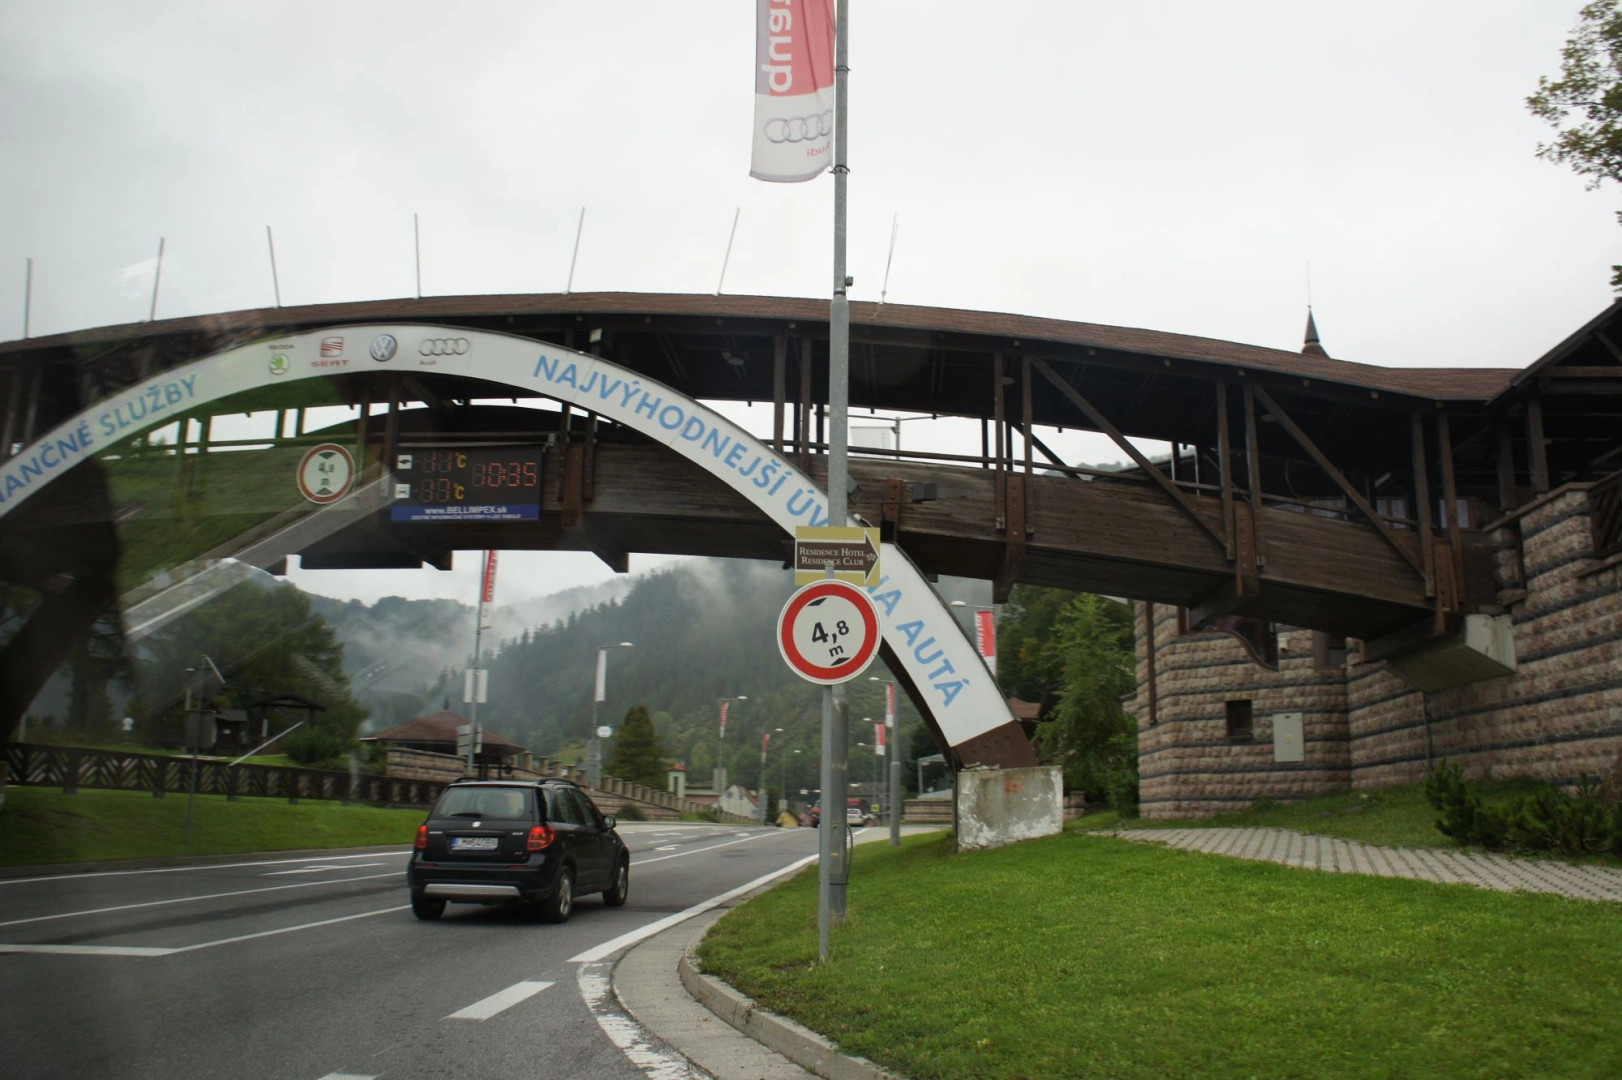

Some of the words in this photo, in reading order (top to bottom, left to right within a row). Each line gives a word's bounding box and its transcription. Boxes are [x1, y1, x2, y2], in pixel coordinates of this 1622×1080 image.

[311, 359, 349, 367] SEAT
[0, 420, 93, 503] ANČNÉ
[99, 374, 197, 437] SLUŽBY
[481, 462, 537, 487] 10:35
[533, 355, 793, 497] NAJVÝHODNEJŠÍ
[895, 620, 970, 708] AUTÁ
[799, 547, 840, 556] RESIDENCE
[841, 548, 865, 557] HOTEL
[843, 557, 864, 566] CLUB
[811, 620, 850, 645] 4,8
[829, 645, 844, 657] m
